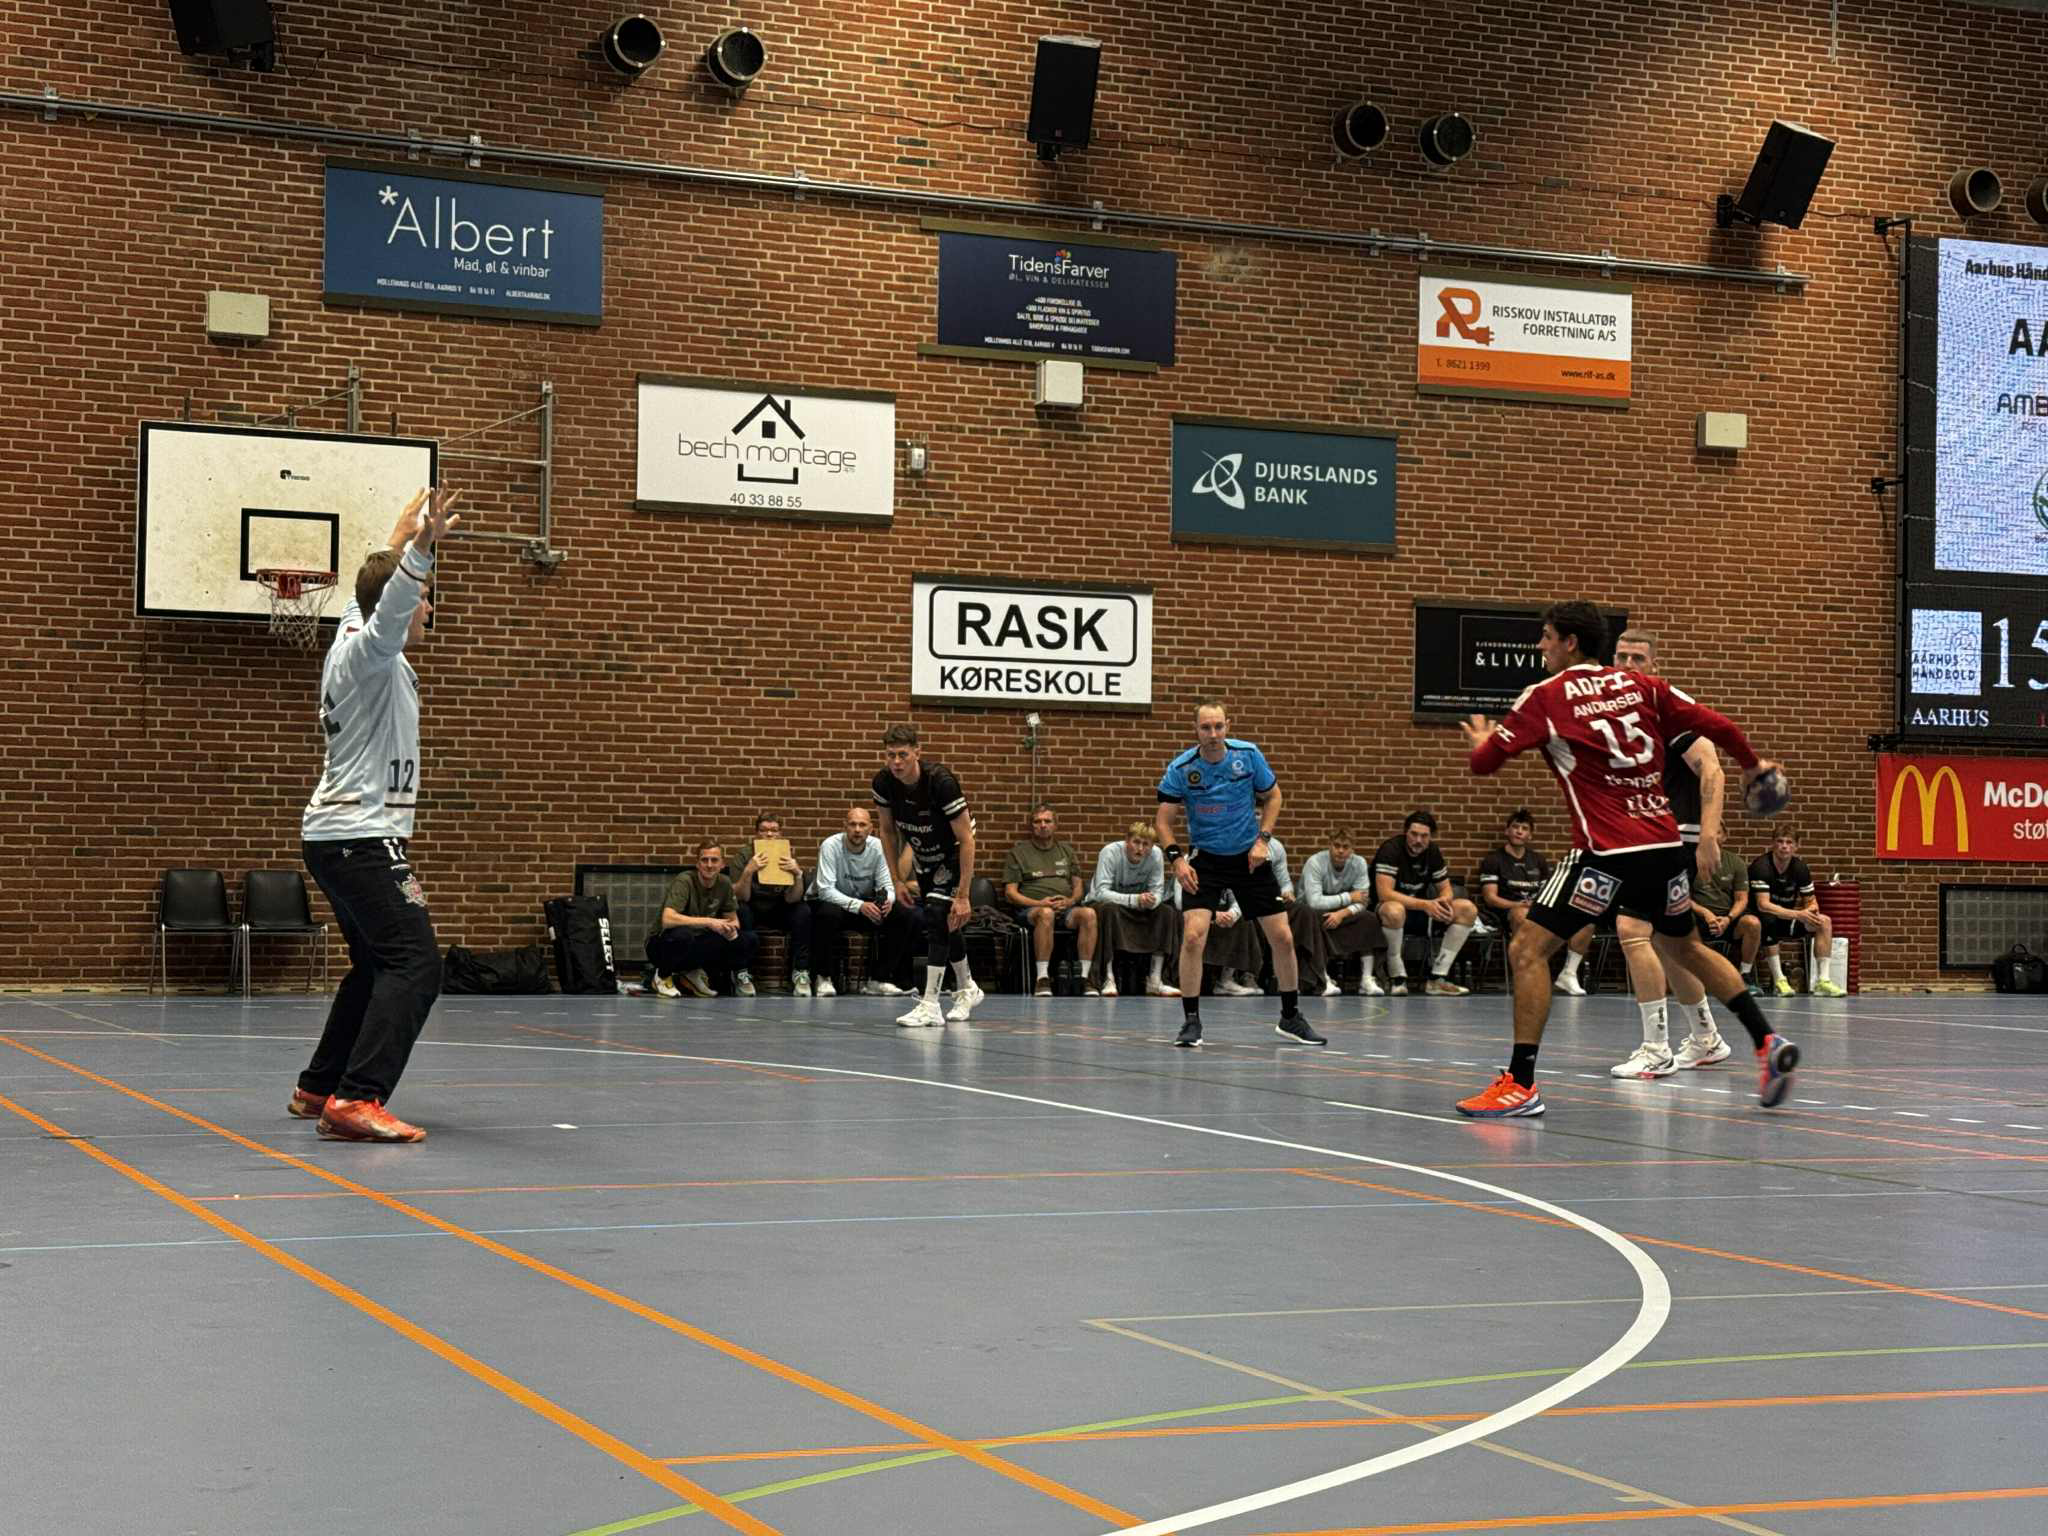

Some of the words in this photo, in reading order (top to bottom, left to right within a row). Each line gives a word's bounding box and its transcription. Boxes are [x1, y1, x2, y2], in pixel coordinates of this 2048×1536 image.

[454, 257, 482, 273] Mad,
[485, 260, 497, 274] øl
[500, 262, 509, 274] &
[512, 263, 551, 279] vinbar
[1008, 253, 1109, 280] TidensFarver
[1965, 259, 2014, 279] Aarhus
[1025, 273, 1040, 283] VIN
[1043, 275, 1048, 283] &
[1492, 305, 1541, 320] RISSKOV
[1543, 310, 1617, 327] INSTALLATØR
[1523, 323, 1595, 340] FORRETNING
[1597, 330, 1617, 342] A/S
[678, 432, 740, 460] bech
[746, 441, 857, 473] montage
[1254, 461, 1378, 486] DJURSLANDS
[729, 492, 746, 504] 40
[749, 494, 765, 506] 33
[768, 495, 784, 507] 88
[786, 496, 802, 508] 55
[1254, 486, 1308, 505] BANK
[957, 601, 1109, 652] RASK
[1913, 653, 1959, 666] AARHUS
[939, 665, 1122, 696] KØRESKOLE
[1911, 708, 1990, 727] AARHUS
[1589, 711, 1655, 769] 15
[387, 759, 415, 793] 12
[1984, 781, 2048, 808] McD
[2013, 818, 2048, 840] stø
[598, 917, 615, 973] SELECT
